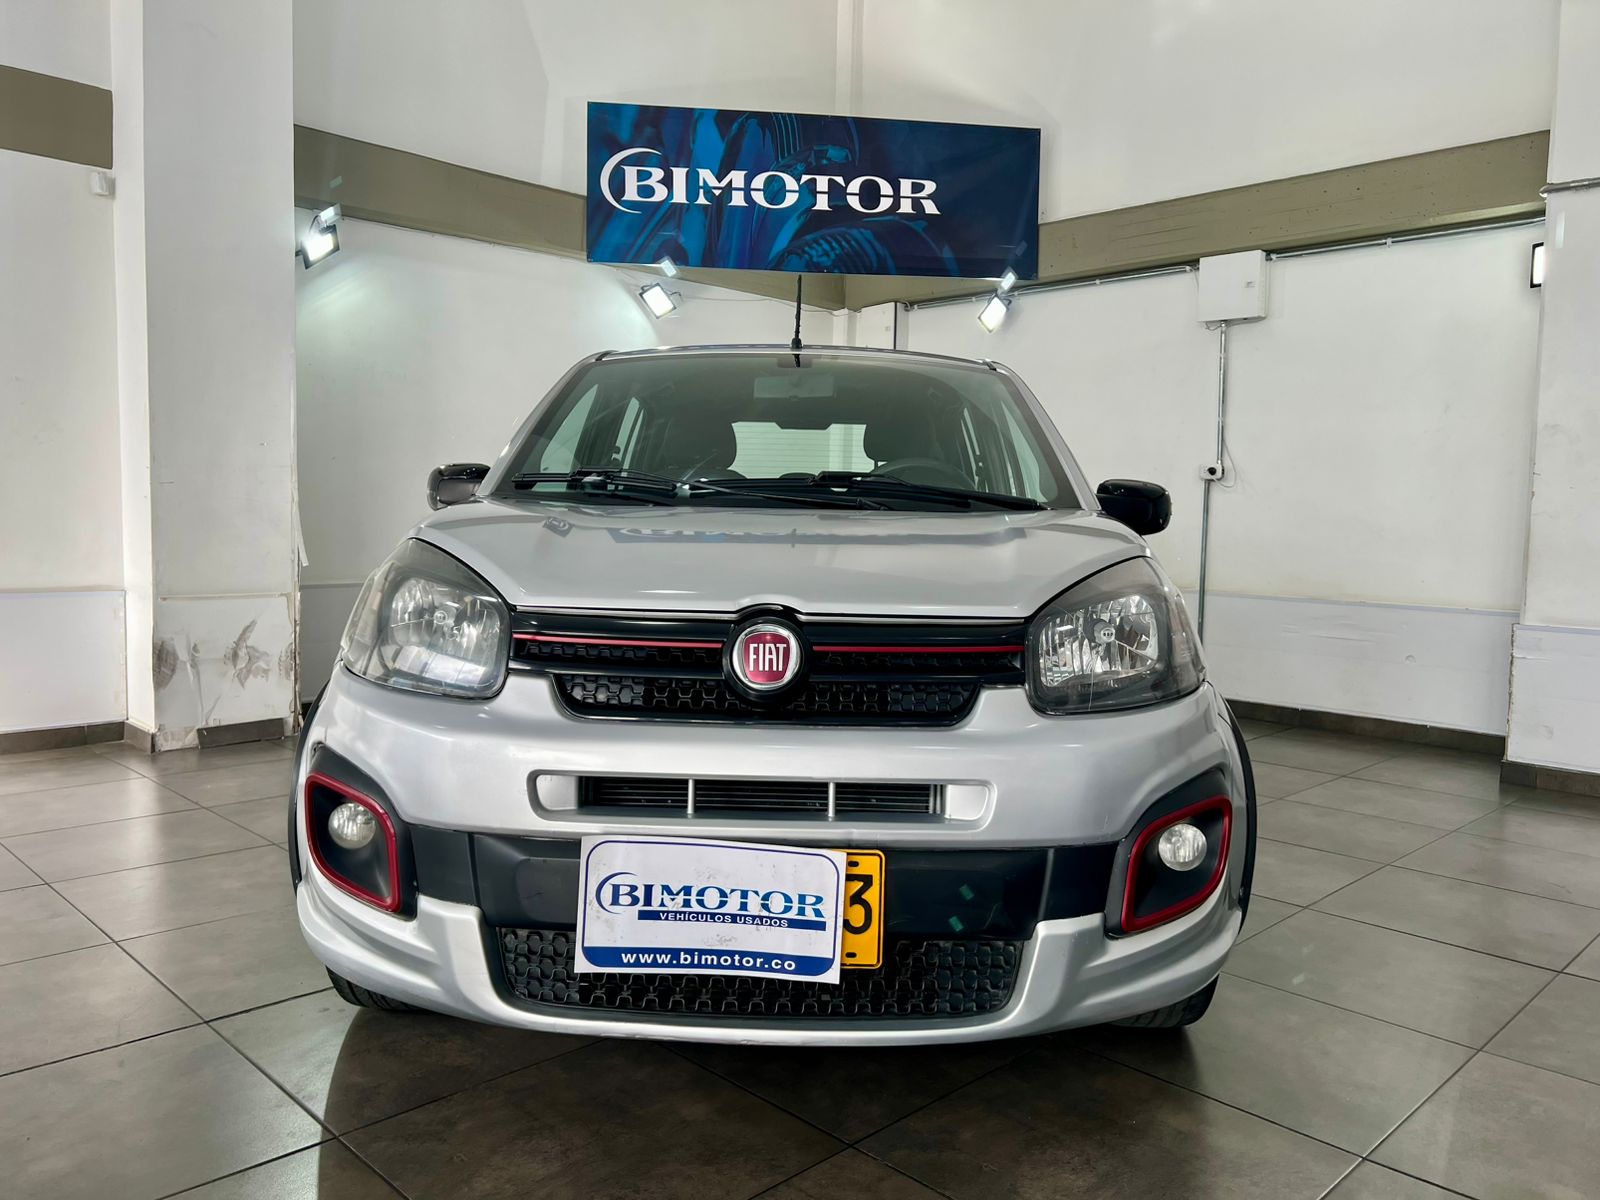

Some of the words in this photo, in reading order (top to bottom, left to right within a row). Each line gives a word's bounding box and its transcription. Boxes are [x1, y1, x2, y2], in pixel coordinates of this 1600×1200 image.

[620, 165, 940, 215] BIMOTOR
[749, 643, 787, 671] FIAT
[609, 883, 825, 919] BIMOTOR
[845, 873, 873, 934] 3
[659, 912, 732, 923] VEHÍCULOS
[737, 914, 788, 927] USADOS
[621, 952, 796, 971] www.bimotor.co
